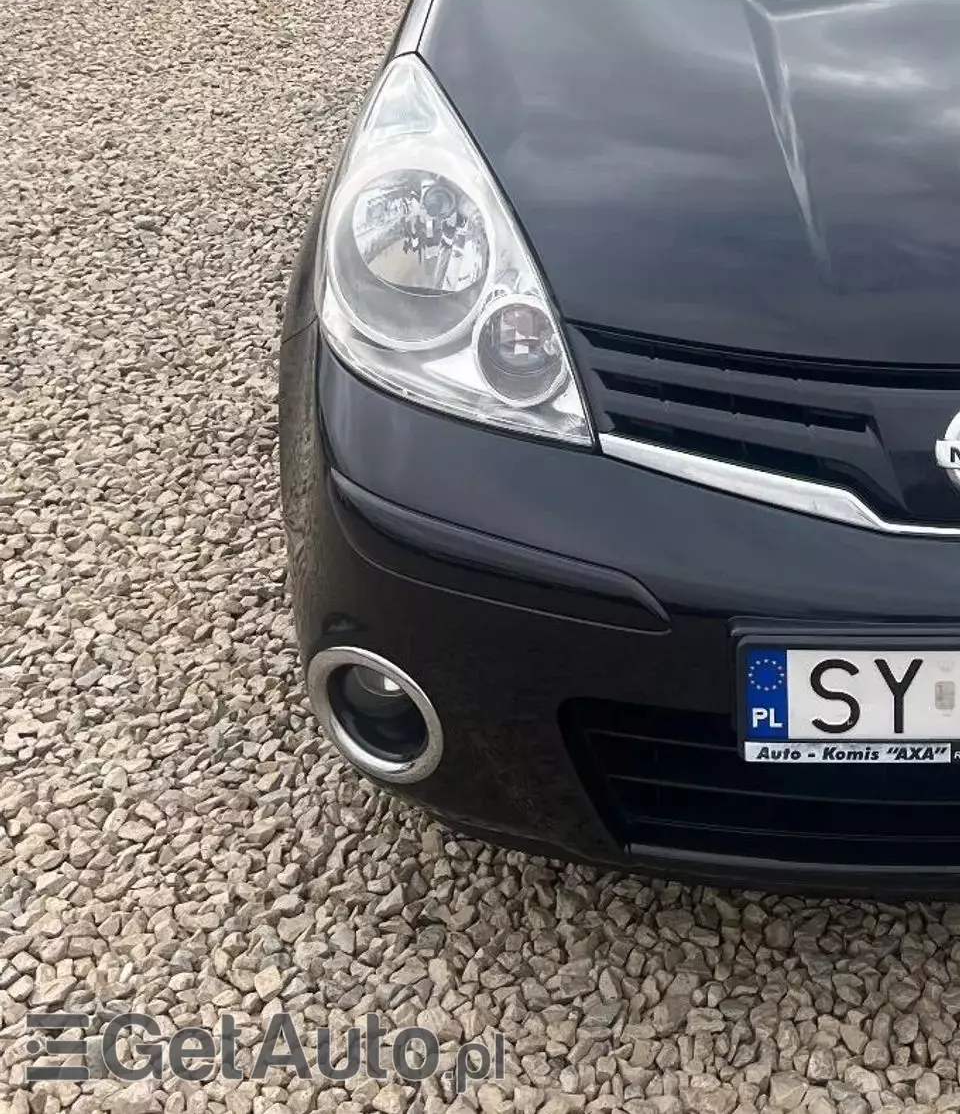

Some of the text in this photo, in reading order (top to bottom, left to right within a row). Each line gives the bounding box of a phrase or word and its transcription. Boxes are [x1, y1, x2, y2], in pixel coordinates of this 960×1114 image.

[810, 658, 924, 734] SY
[752, 707, 782, 728] PL
[757, 746, 801, 761] Auto
[821, 746, 880, 761] Komis
